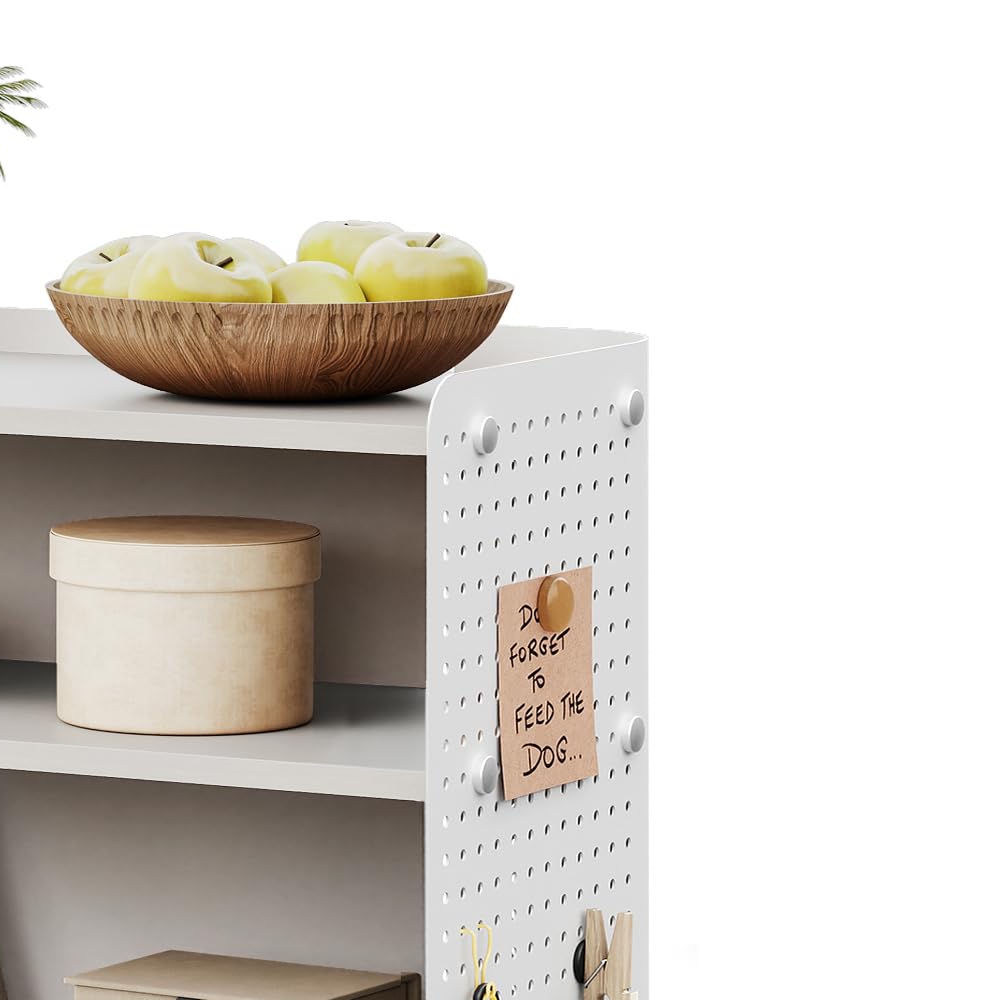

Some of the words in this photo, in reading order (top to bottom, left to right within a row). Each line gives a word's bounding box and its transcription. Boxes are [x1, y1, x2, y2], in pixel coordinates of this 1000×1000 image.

[510, 627, 570, 668] FORGET
[528, 667, 546, 694] TO
[515, 701, 554, 734] FEED
[561, 690, 584, 720] THE
